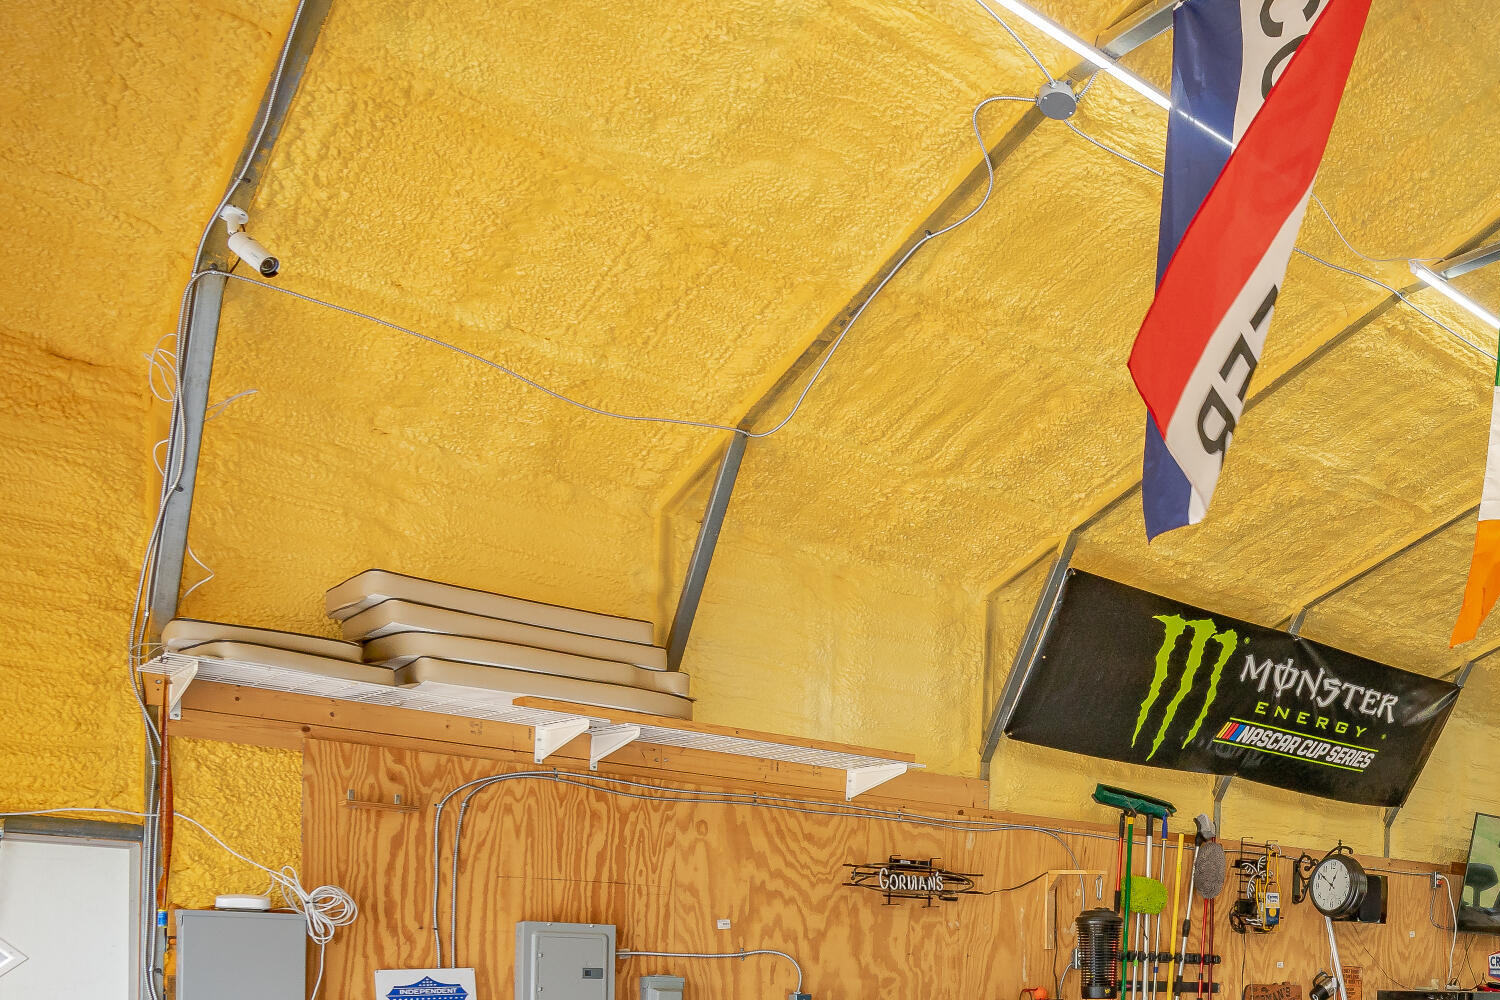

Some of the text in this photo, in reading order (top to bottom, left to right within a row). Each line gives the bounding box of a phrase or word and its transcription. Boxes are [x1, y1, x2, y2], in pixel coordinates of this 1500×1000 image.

[1240, 653, 1399, 724] MONSTER
[1255, 701, 1368, 739] ENERGY
[1235, 725, 1375, 769] NASCAR CUP SERIES
[399, 987, 457, 995] INDEPENDENT
